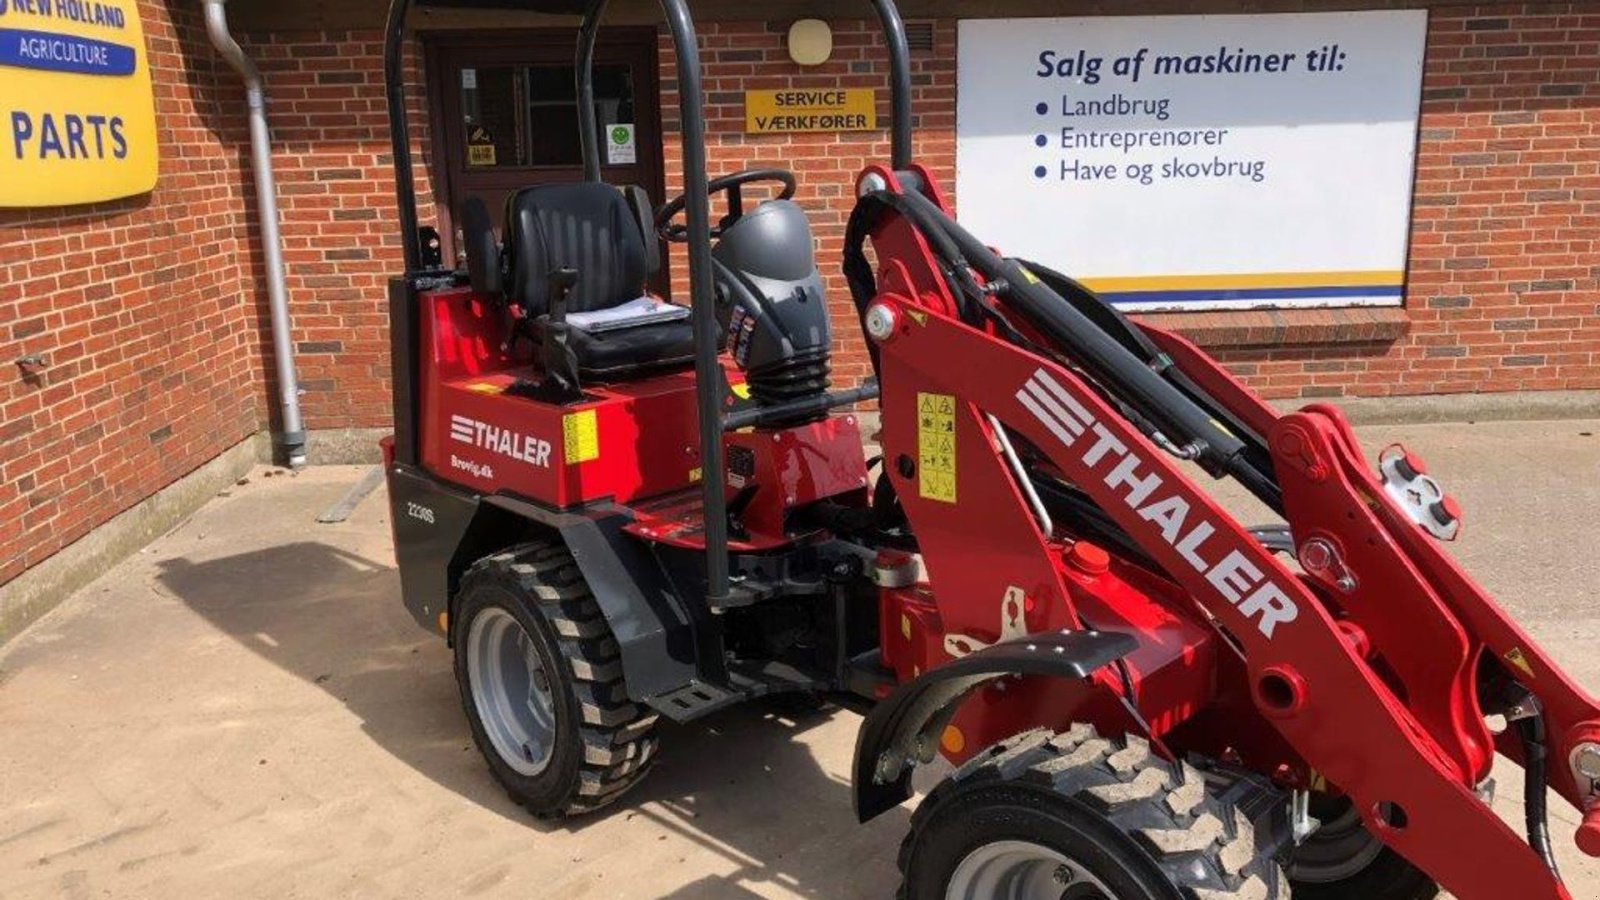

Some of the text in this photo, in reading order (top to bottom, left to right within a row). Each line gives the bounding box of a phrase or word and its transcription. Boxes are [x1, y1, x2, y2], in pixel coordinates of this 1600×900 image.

[12, 0, 125, 29] NEW HOLLAND
[20, 37, 109, 66] AGRICULTURE
[1036, 44, 1347, 84] Salg af maskiner til:
[775, 91, 847, 106] SERVICE
[1061, 94, 1171, 120] Landbrug
[11, 111, 128, 160] PARTS
[755, 114, 867, 129] VÆRKFØRER
[1060, 127, 1229, 154] Entreprenører
[1060, 156, 1266, 186] Have og skovbrug
[473, 420, 552, 469] THALER
[1081, 421, 1299, 641] THALER
